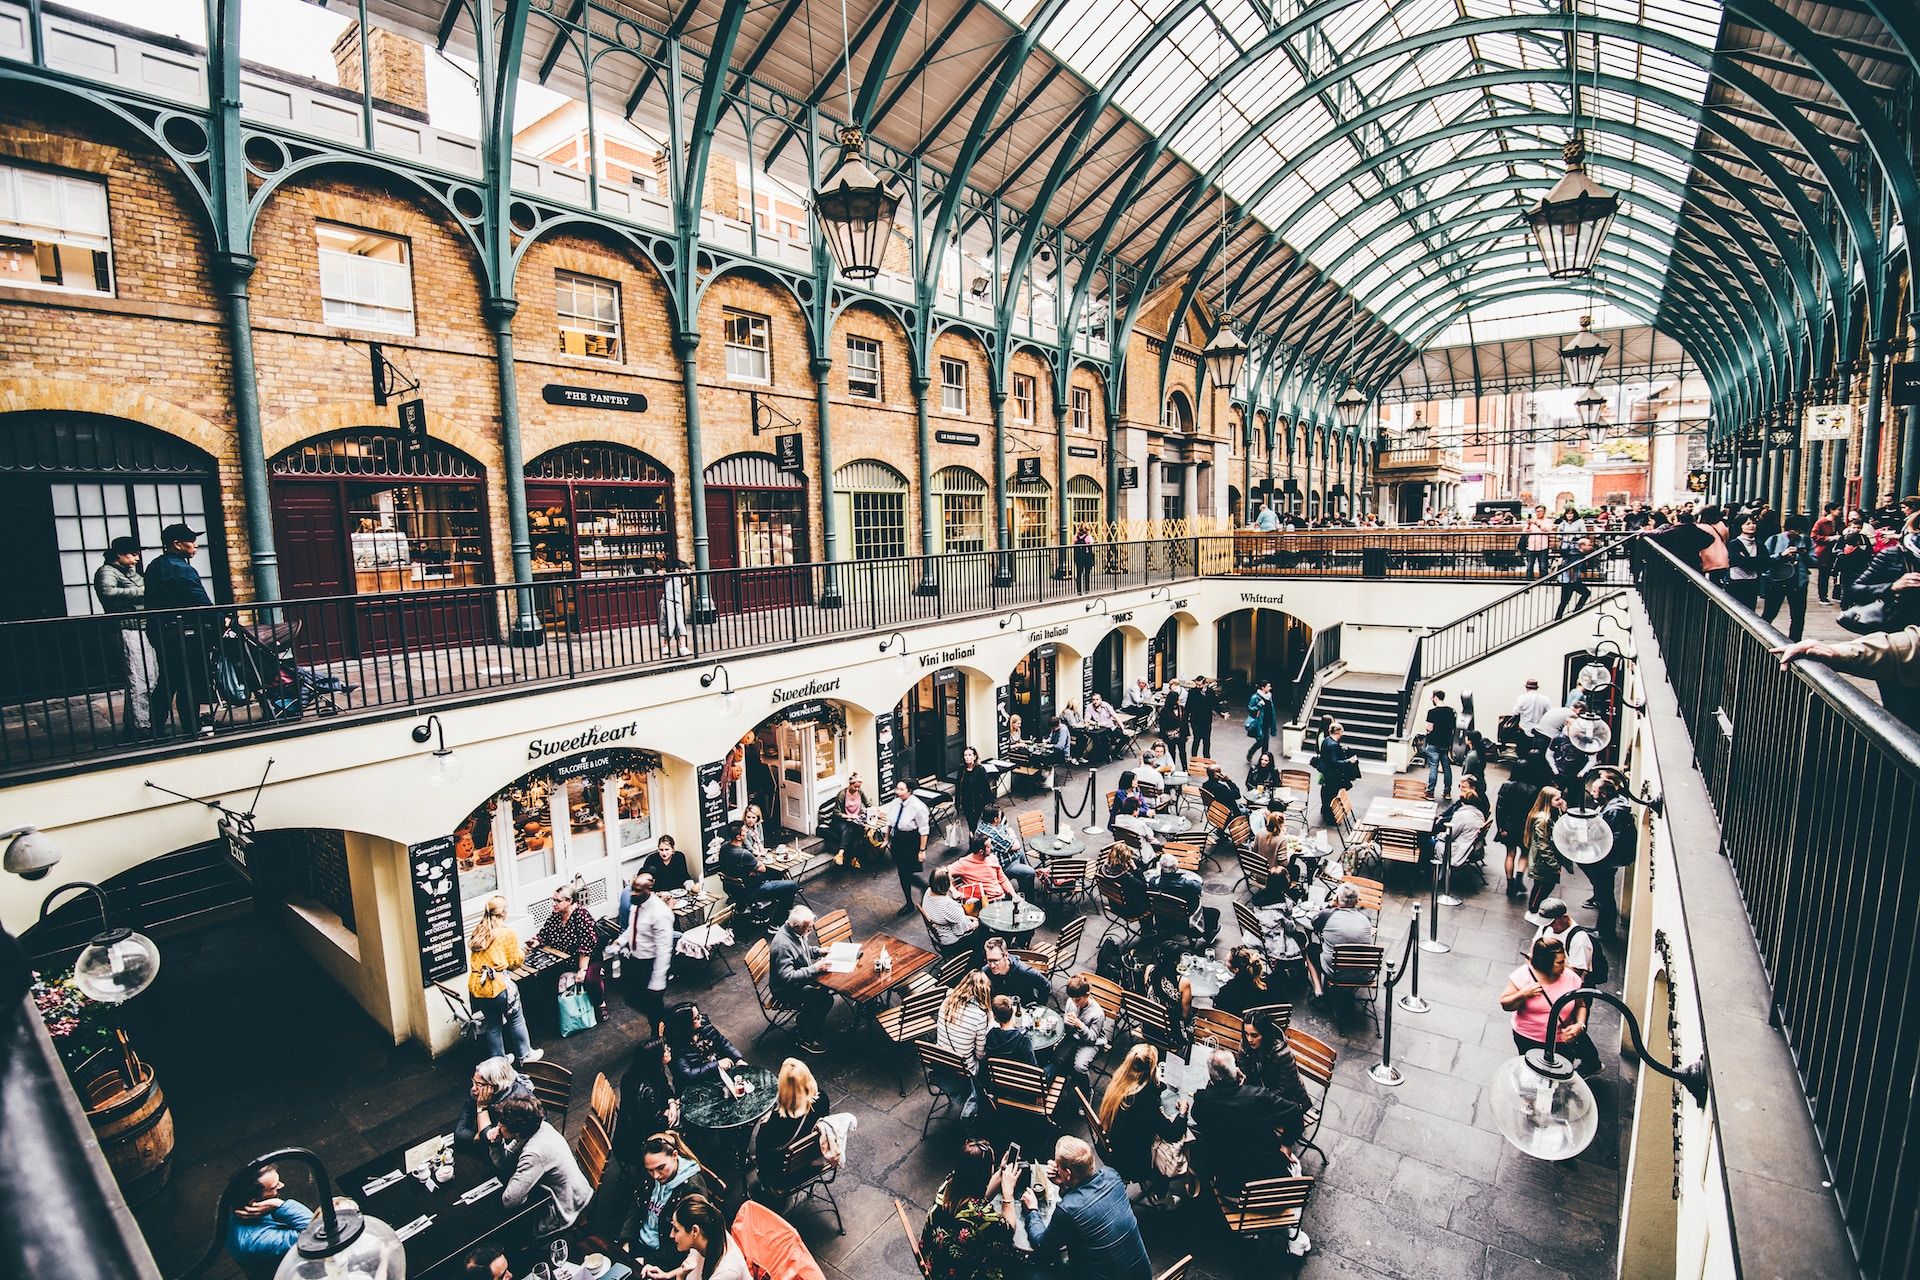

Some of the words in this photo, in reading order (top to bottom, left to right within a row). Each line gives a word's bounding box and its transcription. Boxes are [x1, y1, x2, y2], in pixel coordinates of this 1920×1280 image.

[564, 390, 587, 401] THE
[590, 393, 629, 406] PANTRY
[1240, 593, 1284, 604] Whittard
[1044, 624, 1069, 639] Italiani
[919, 652, 939, 667] Vini
[942, 645, 975, 663] Italiani
[771, 677, 841, 704] Sweetheart
[527, 720, 638, 760] Sweetheart
[595, 757, 609, 767] LOVE
[229, 838, 247, 867] Exit
[415, 842, 449, 858] Sweetheart
